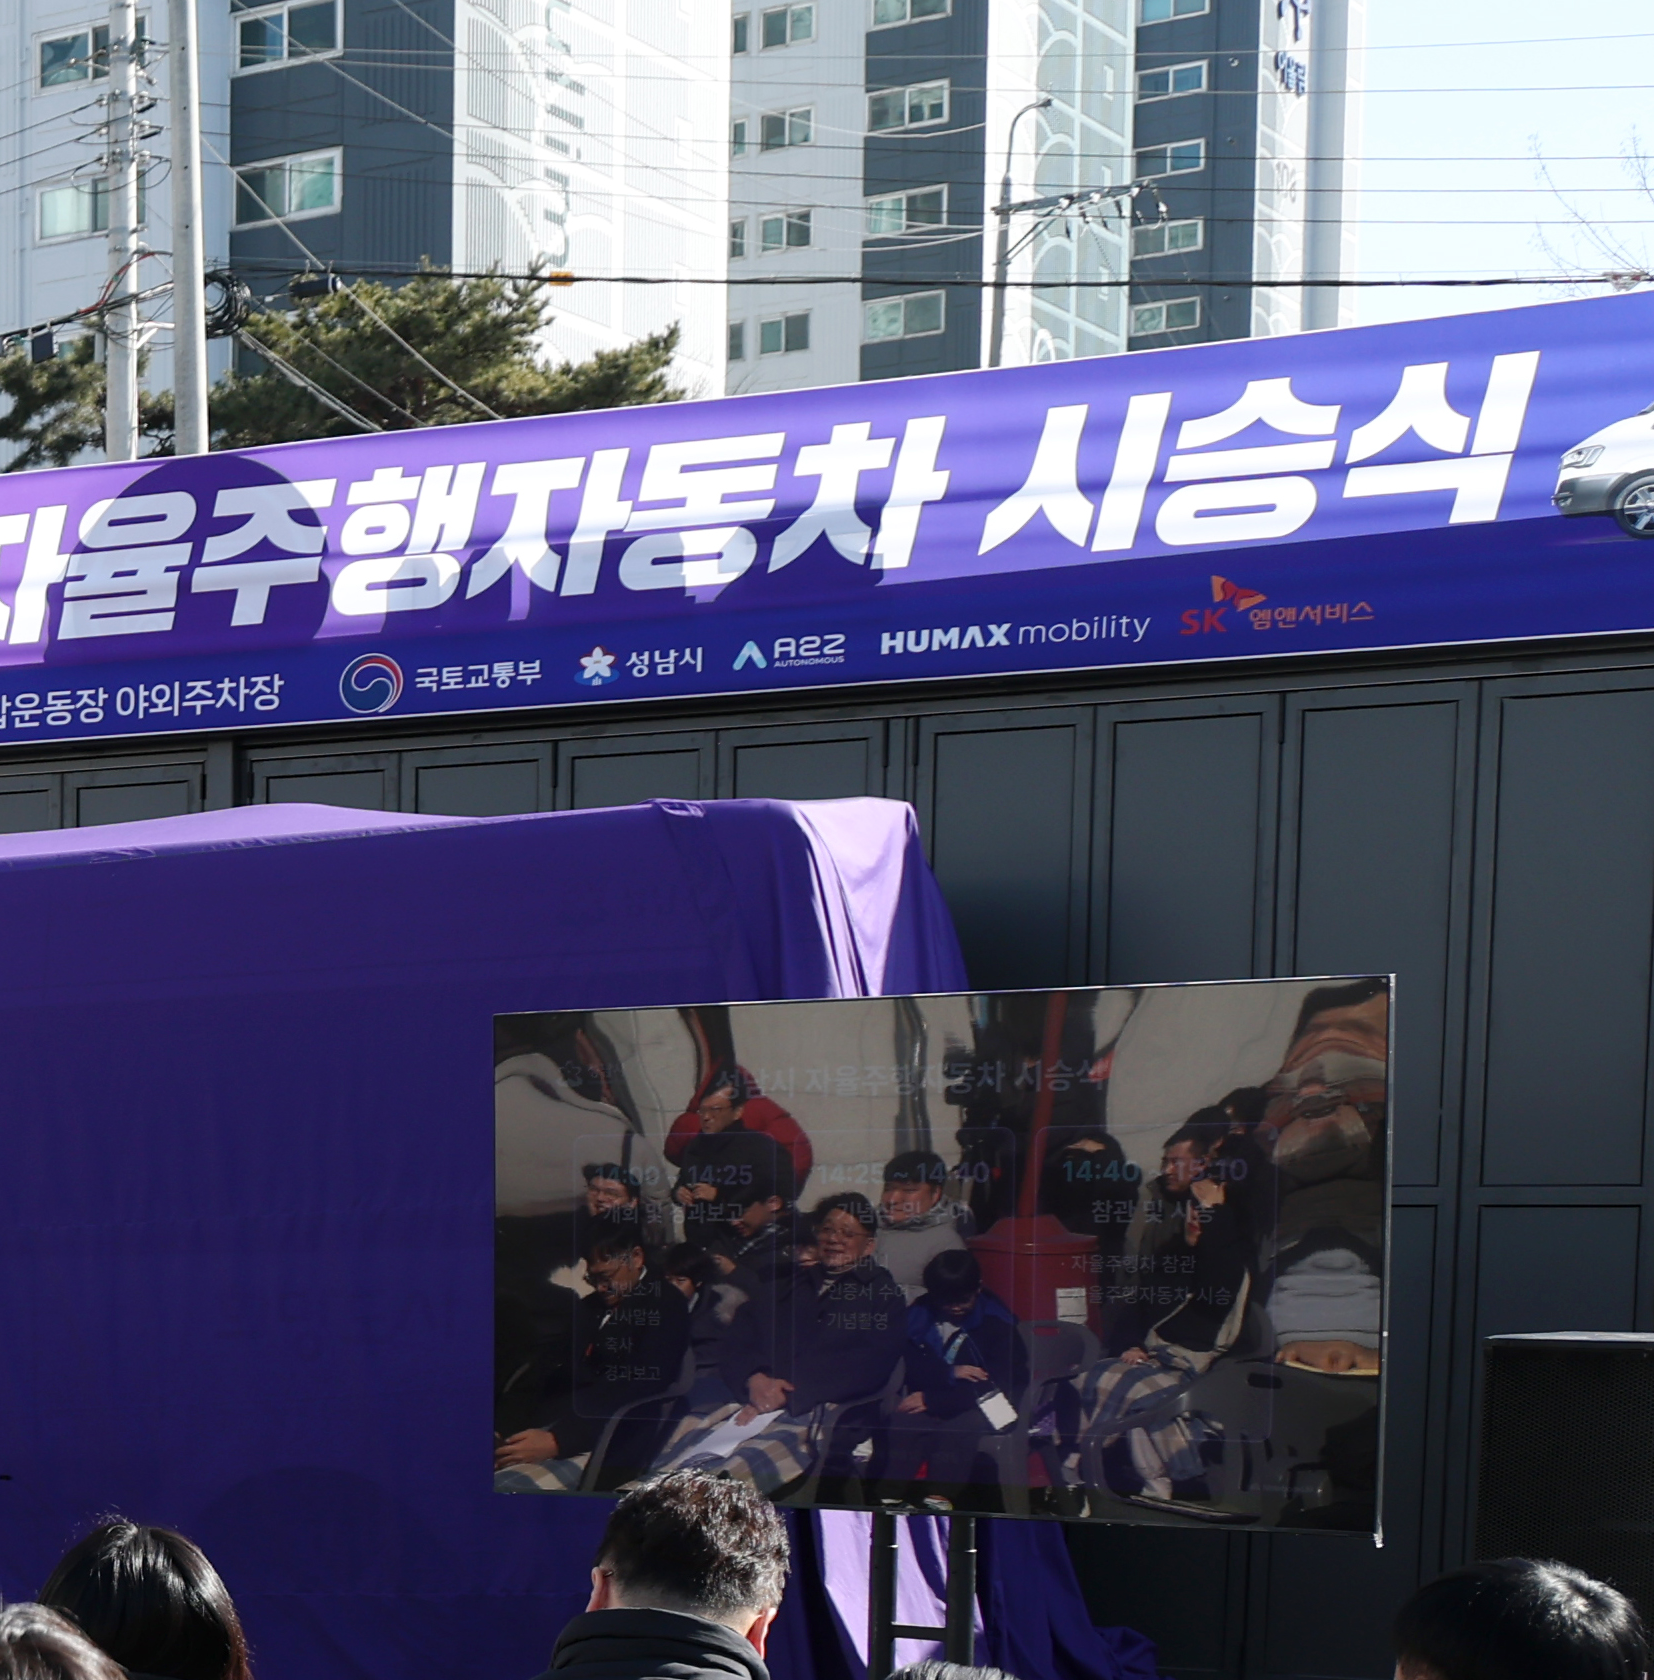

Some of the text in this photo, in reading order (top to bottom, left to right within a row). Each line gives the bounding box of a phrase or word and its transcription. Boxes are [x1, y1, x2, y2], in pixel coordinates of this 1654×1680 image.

[976, 349, 1542, 556] 시승식
[1179, 600, 1375, 636] SK 엠앤서비스
[879, 610, 1152, 656] HUMAX mobility
[624, 645, 705, 680] 성남시
[773, 655, 845, 668] AUTONOMOUS
[413, 658, 543, 695] 국토교통부
[114, 672, 285, 721] 야외주차장
[714, 1066, 795, 1100] 성남시
[687, 1163, 755, 1187] 14:25
[818, 1162, 885, 1185] 14:25
[1061, 1159, 1142, 1183] 14:40
[645, 1202, 664, 1225] 및
[1090, 1198, 1135, 1225] 참관
[1141, 1199, 1163, 1224] 및
[1070, 1253, 1197, 1274] 자율주행차 참관
[829, 1281, 874, 1302] 인증서
[1196, 1284, 1233, 1306] 시승
[605, 1308, 662, 1327] 인사말씀
[605, 1336, 634, 1354] 축사
[605, 1364, 662, 1382] 경과보고
